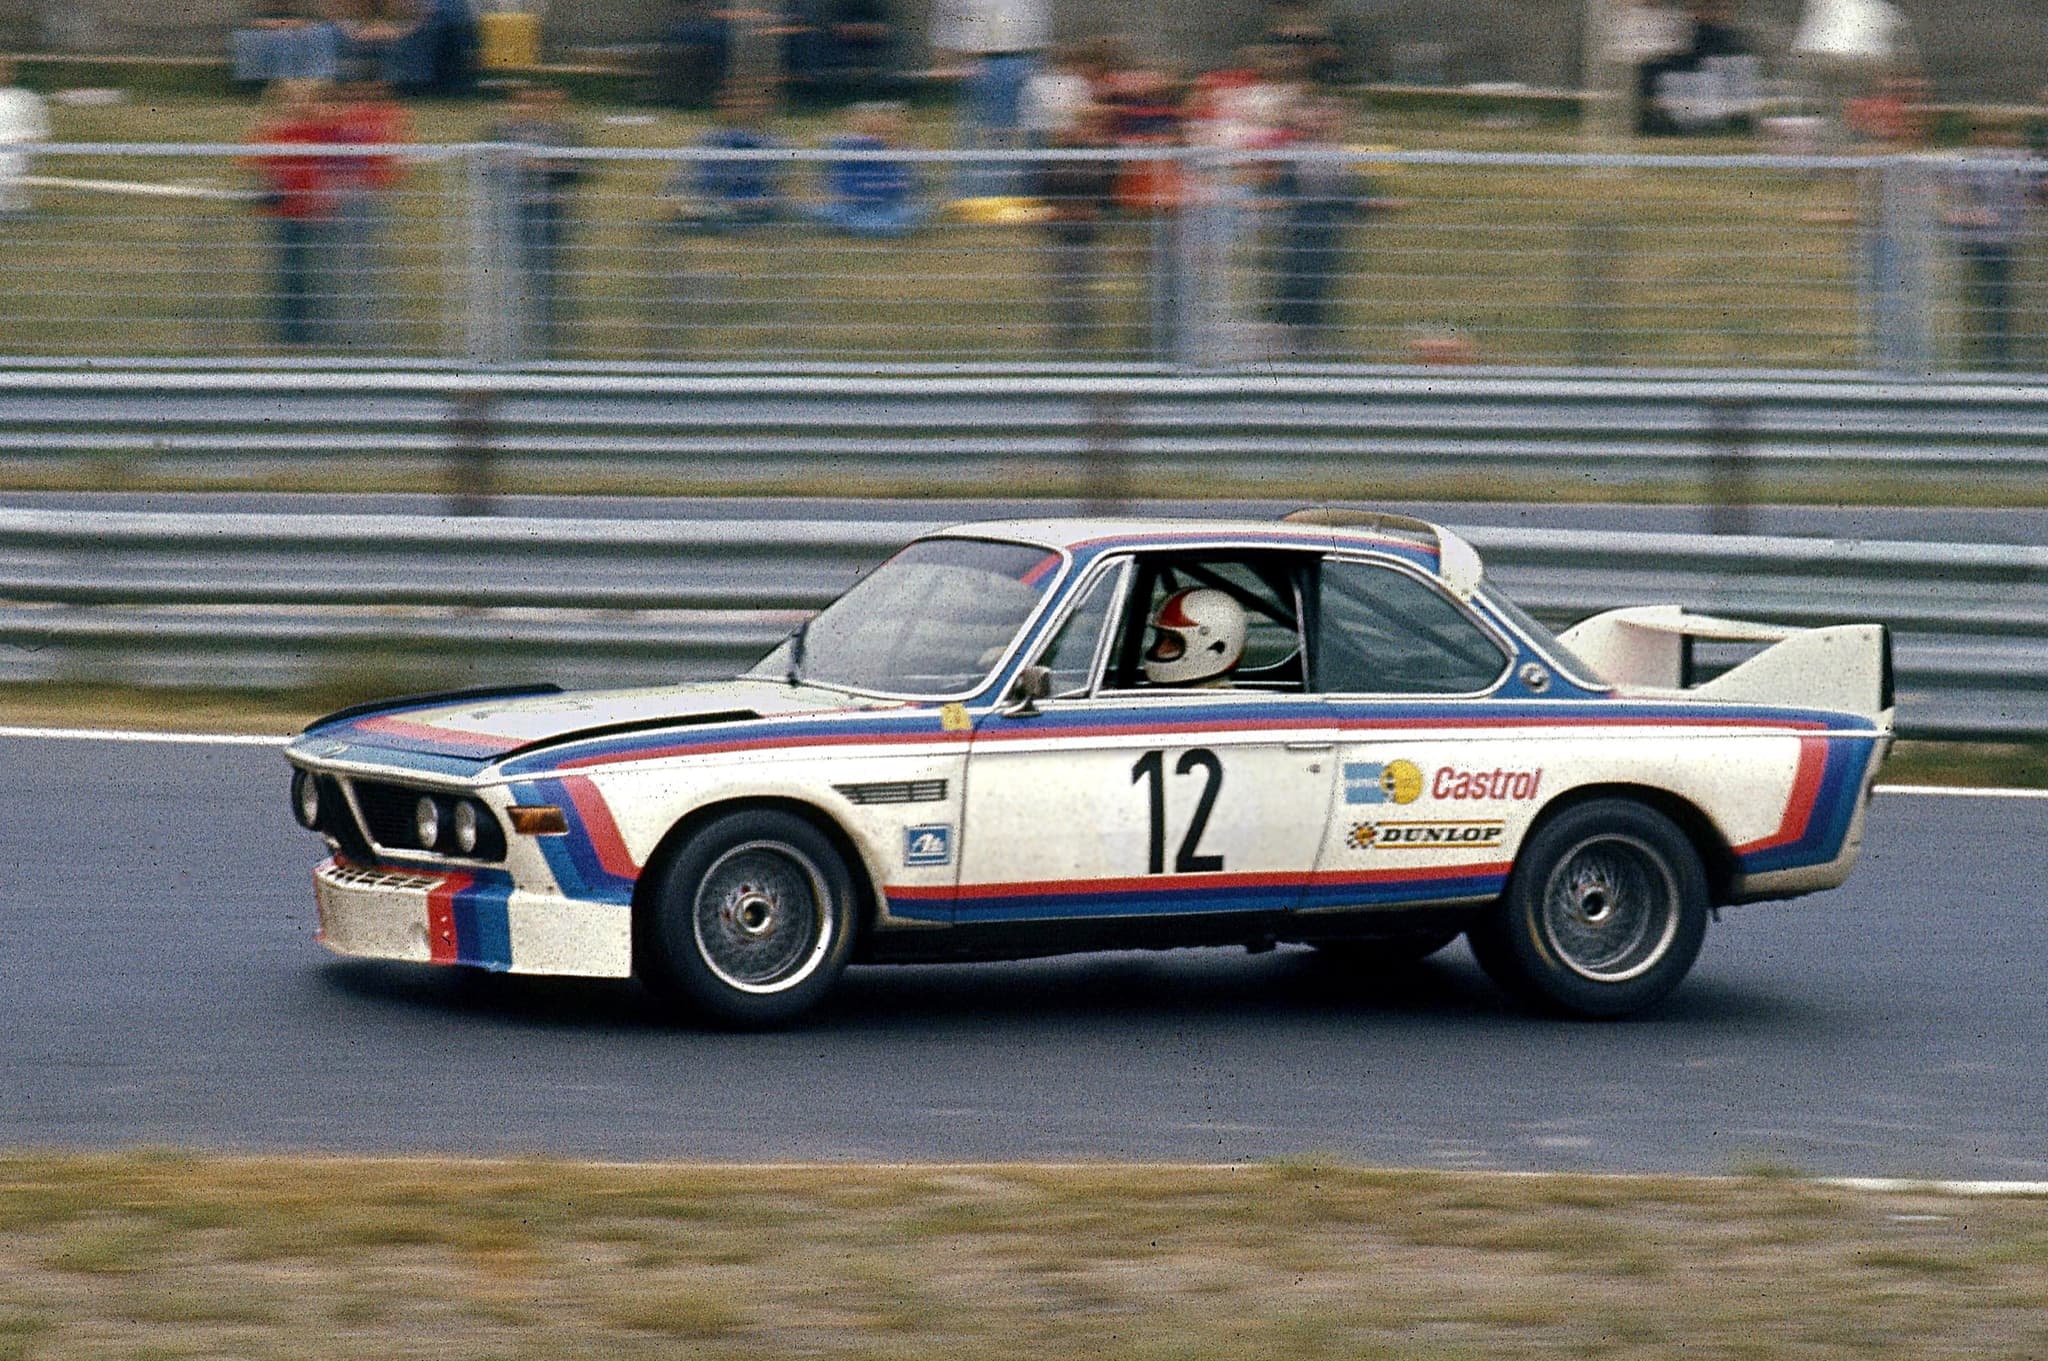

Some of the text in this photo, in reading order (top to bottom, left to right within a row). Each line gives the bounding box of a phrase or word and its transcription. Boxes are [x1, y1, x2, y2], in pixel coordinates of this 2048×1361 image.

[1432, 766, 1542, 800] Castrol
[1132, 748, 1224, 874] 12
[1382, 827, 1502, 842] DUNLOP
